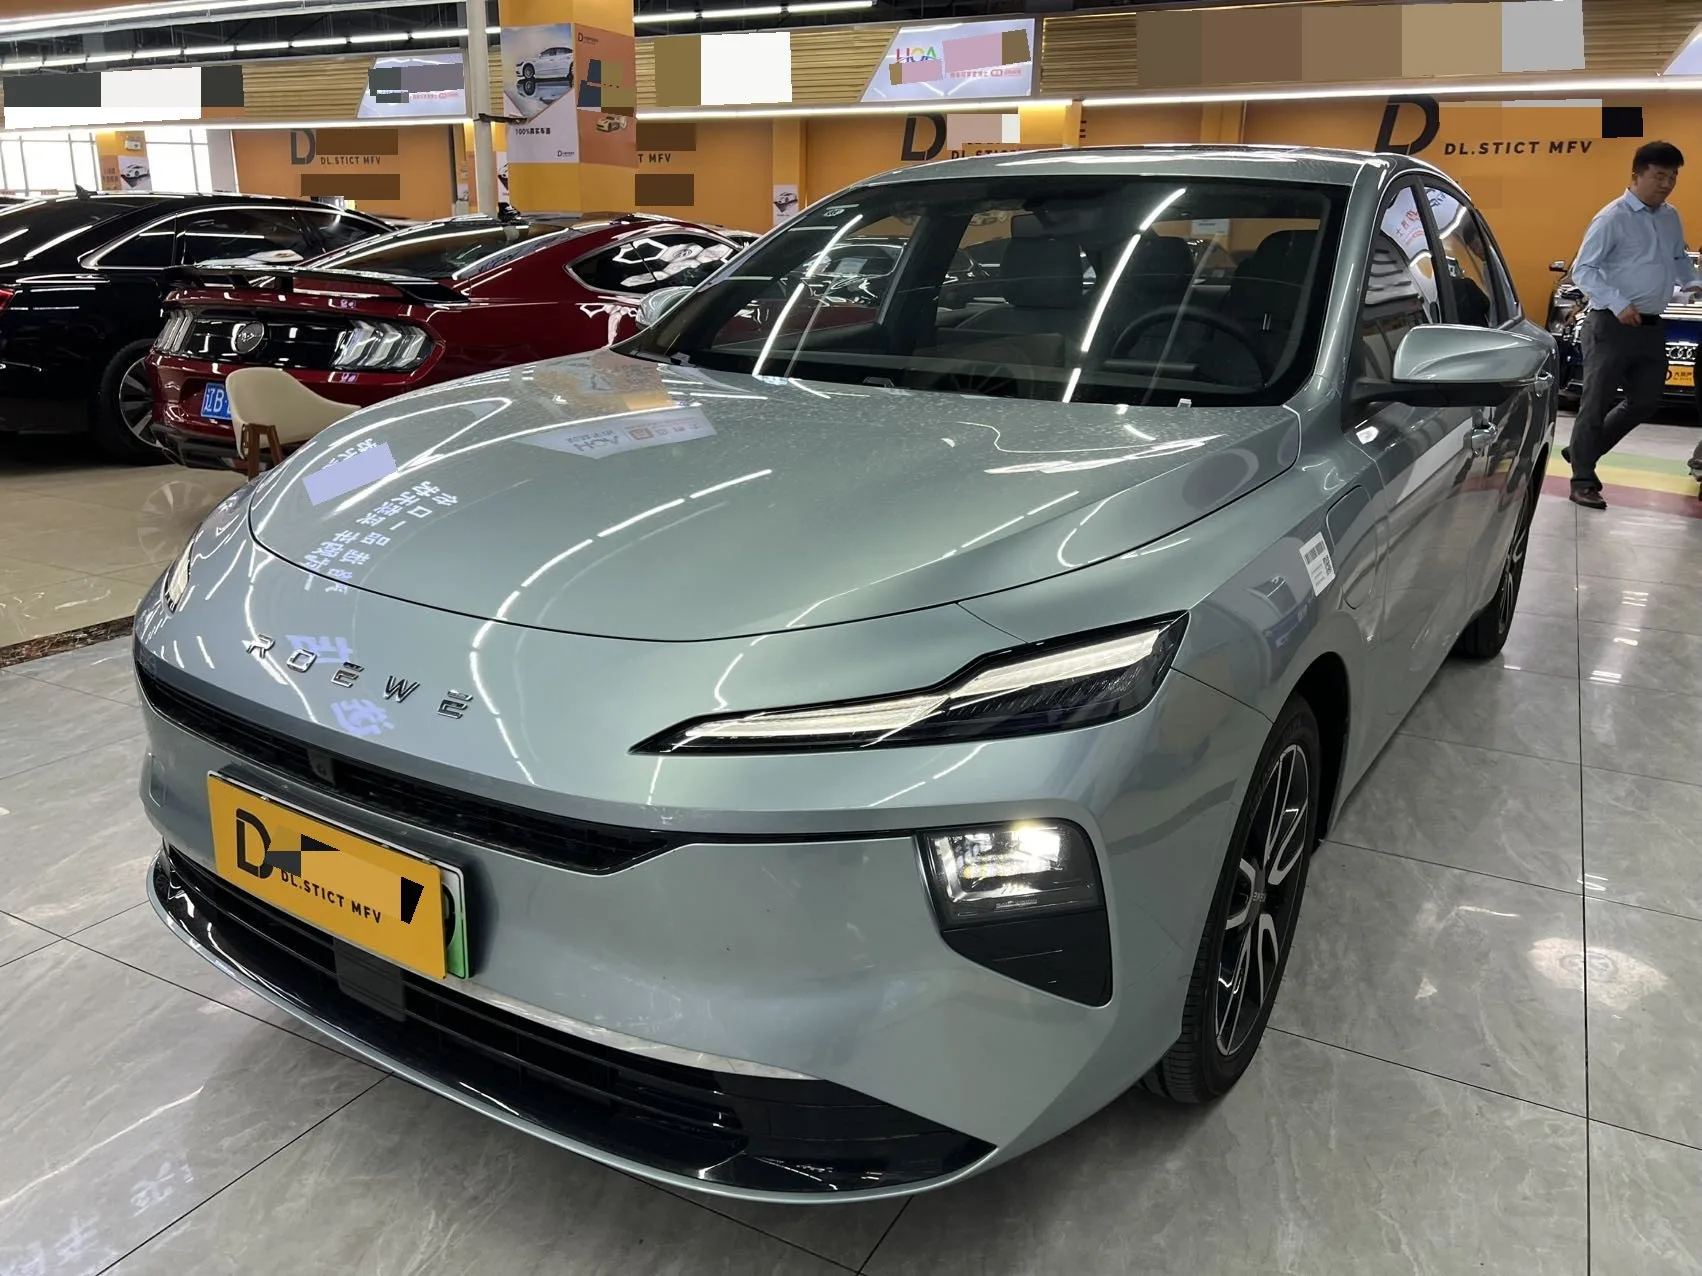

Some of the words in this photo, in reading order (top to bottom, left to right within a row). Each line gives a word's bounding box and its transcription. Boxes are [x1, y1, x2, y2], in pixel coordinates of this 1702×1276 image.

[1444, 141, 1540, 155] DL.STICT
[1549, 140, 1593, 154] MFV
[363, 156, 381, 165] MFV
[649, 153, 671, 163] MFV
[246, 634, 474, 719] ROEWE
[281, 870, 344, 908] DL.STICT
[352, 900, 382, 924] MFV
